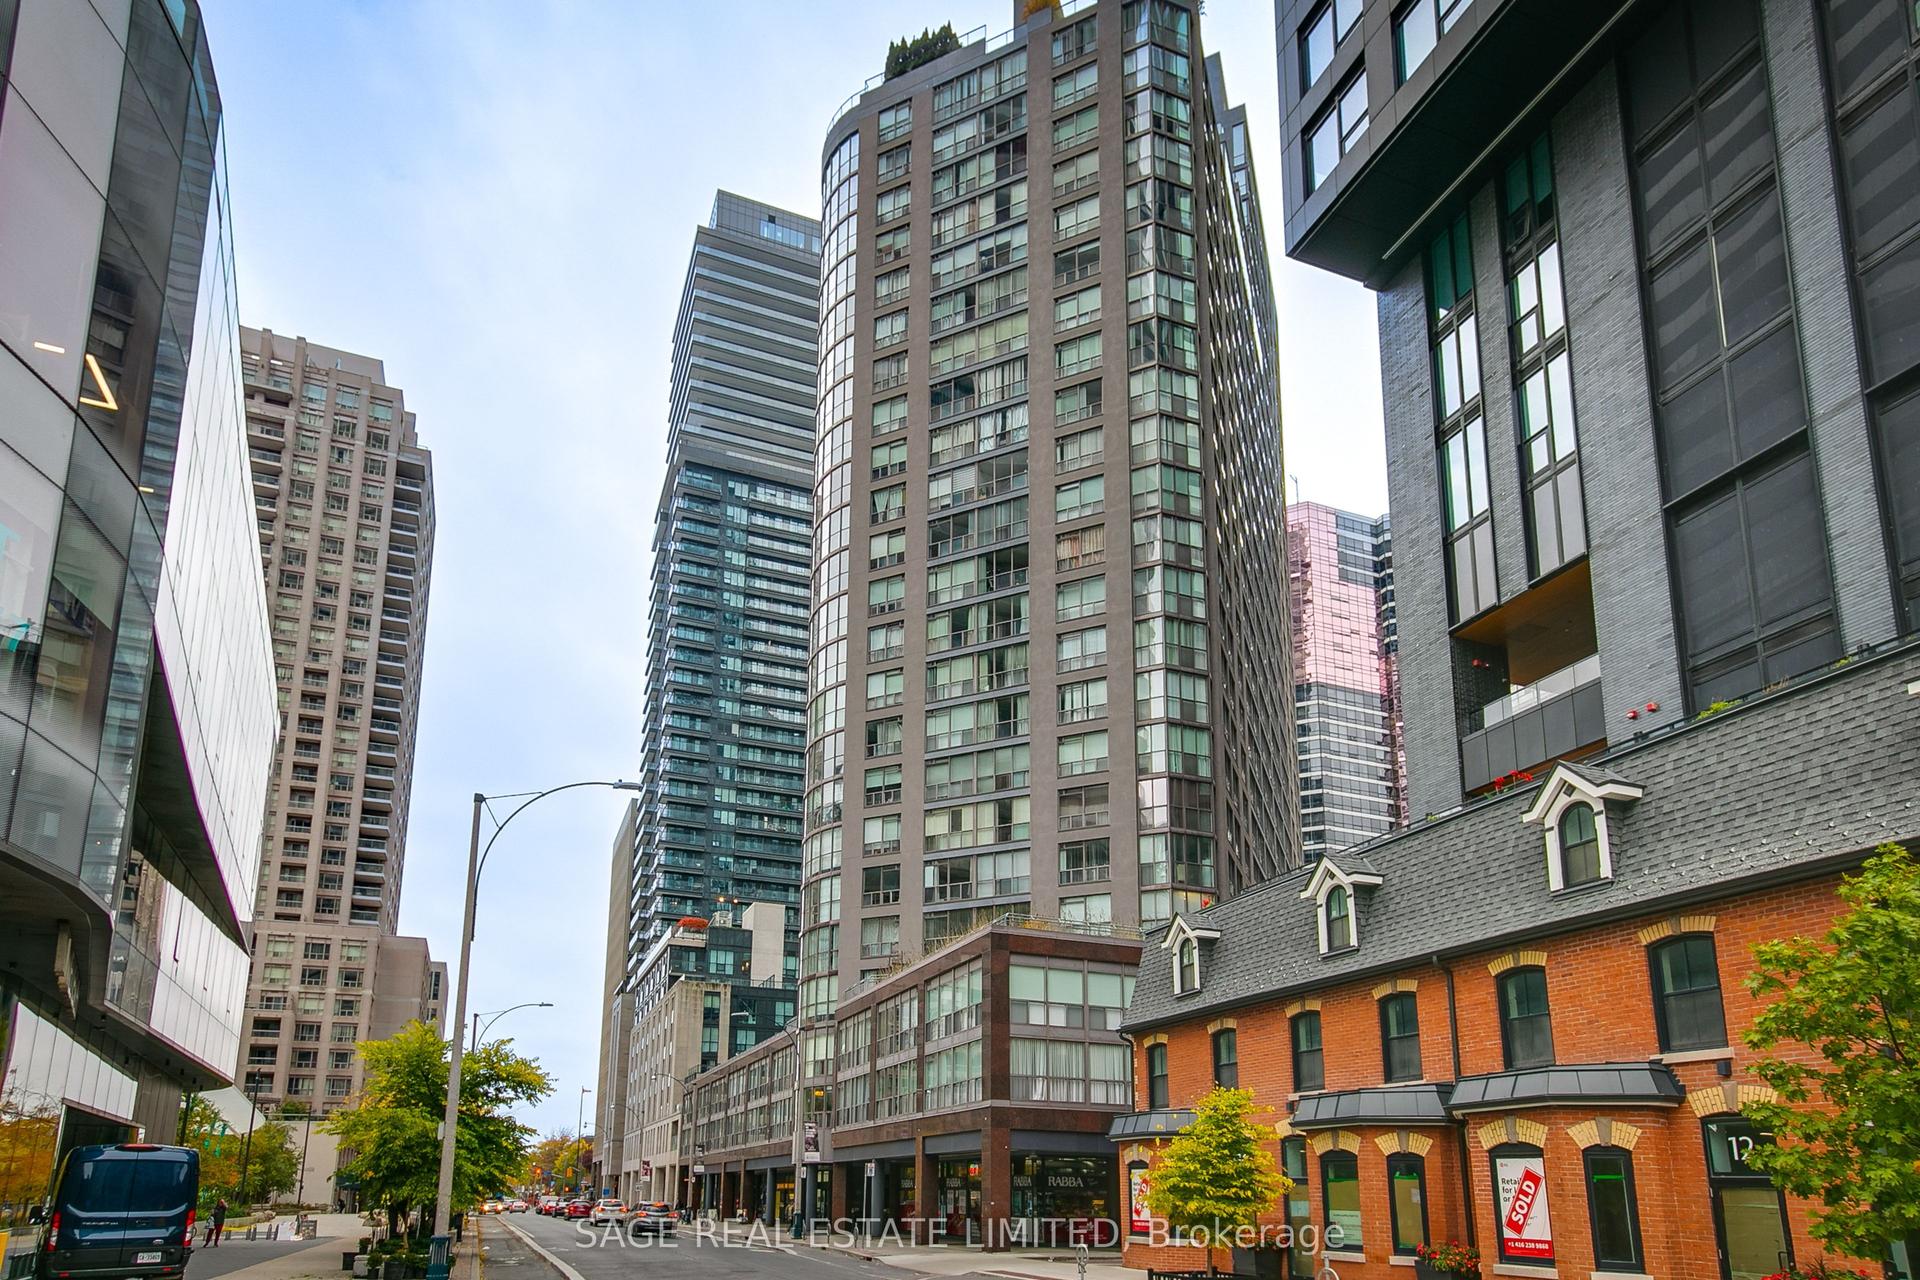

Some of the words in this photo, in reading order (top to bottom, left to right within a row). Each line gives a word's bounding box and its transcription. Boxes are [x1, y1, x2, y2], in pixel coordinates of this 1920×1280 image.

[1013, 1175, 1032, 1187] RABBA
[1047, 1175, 1084, 1188] RABBA
[1502, 1186, 1512, 1194] for
[1511, 1180, 1536, 1225] SOLD
